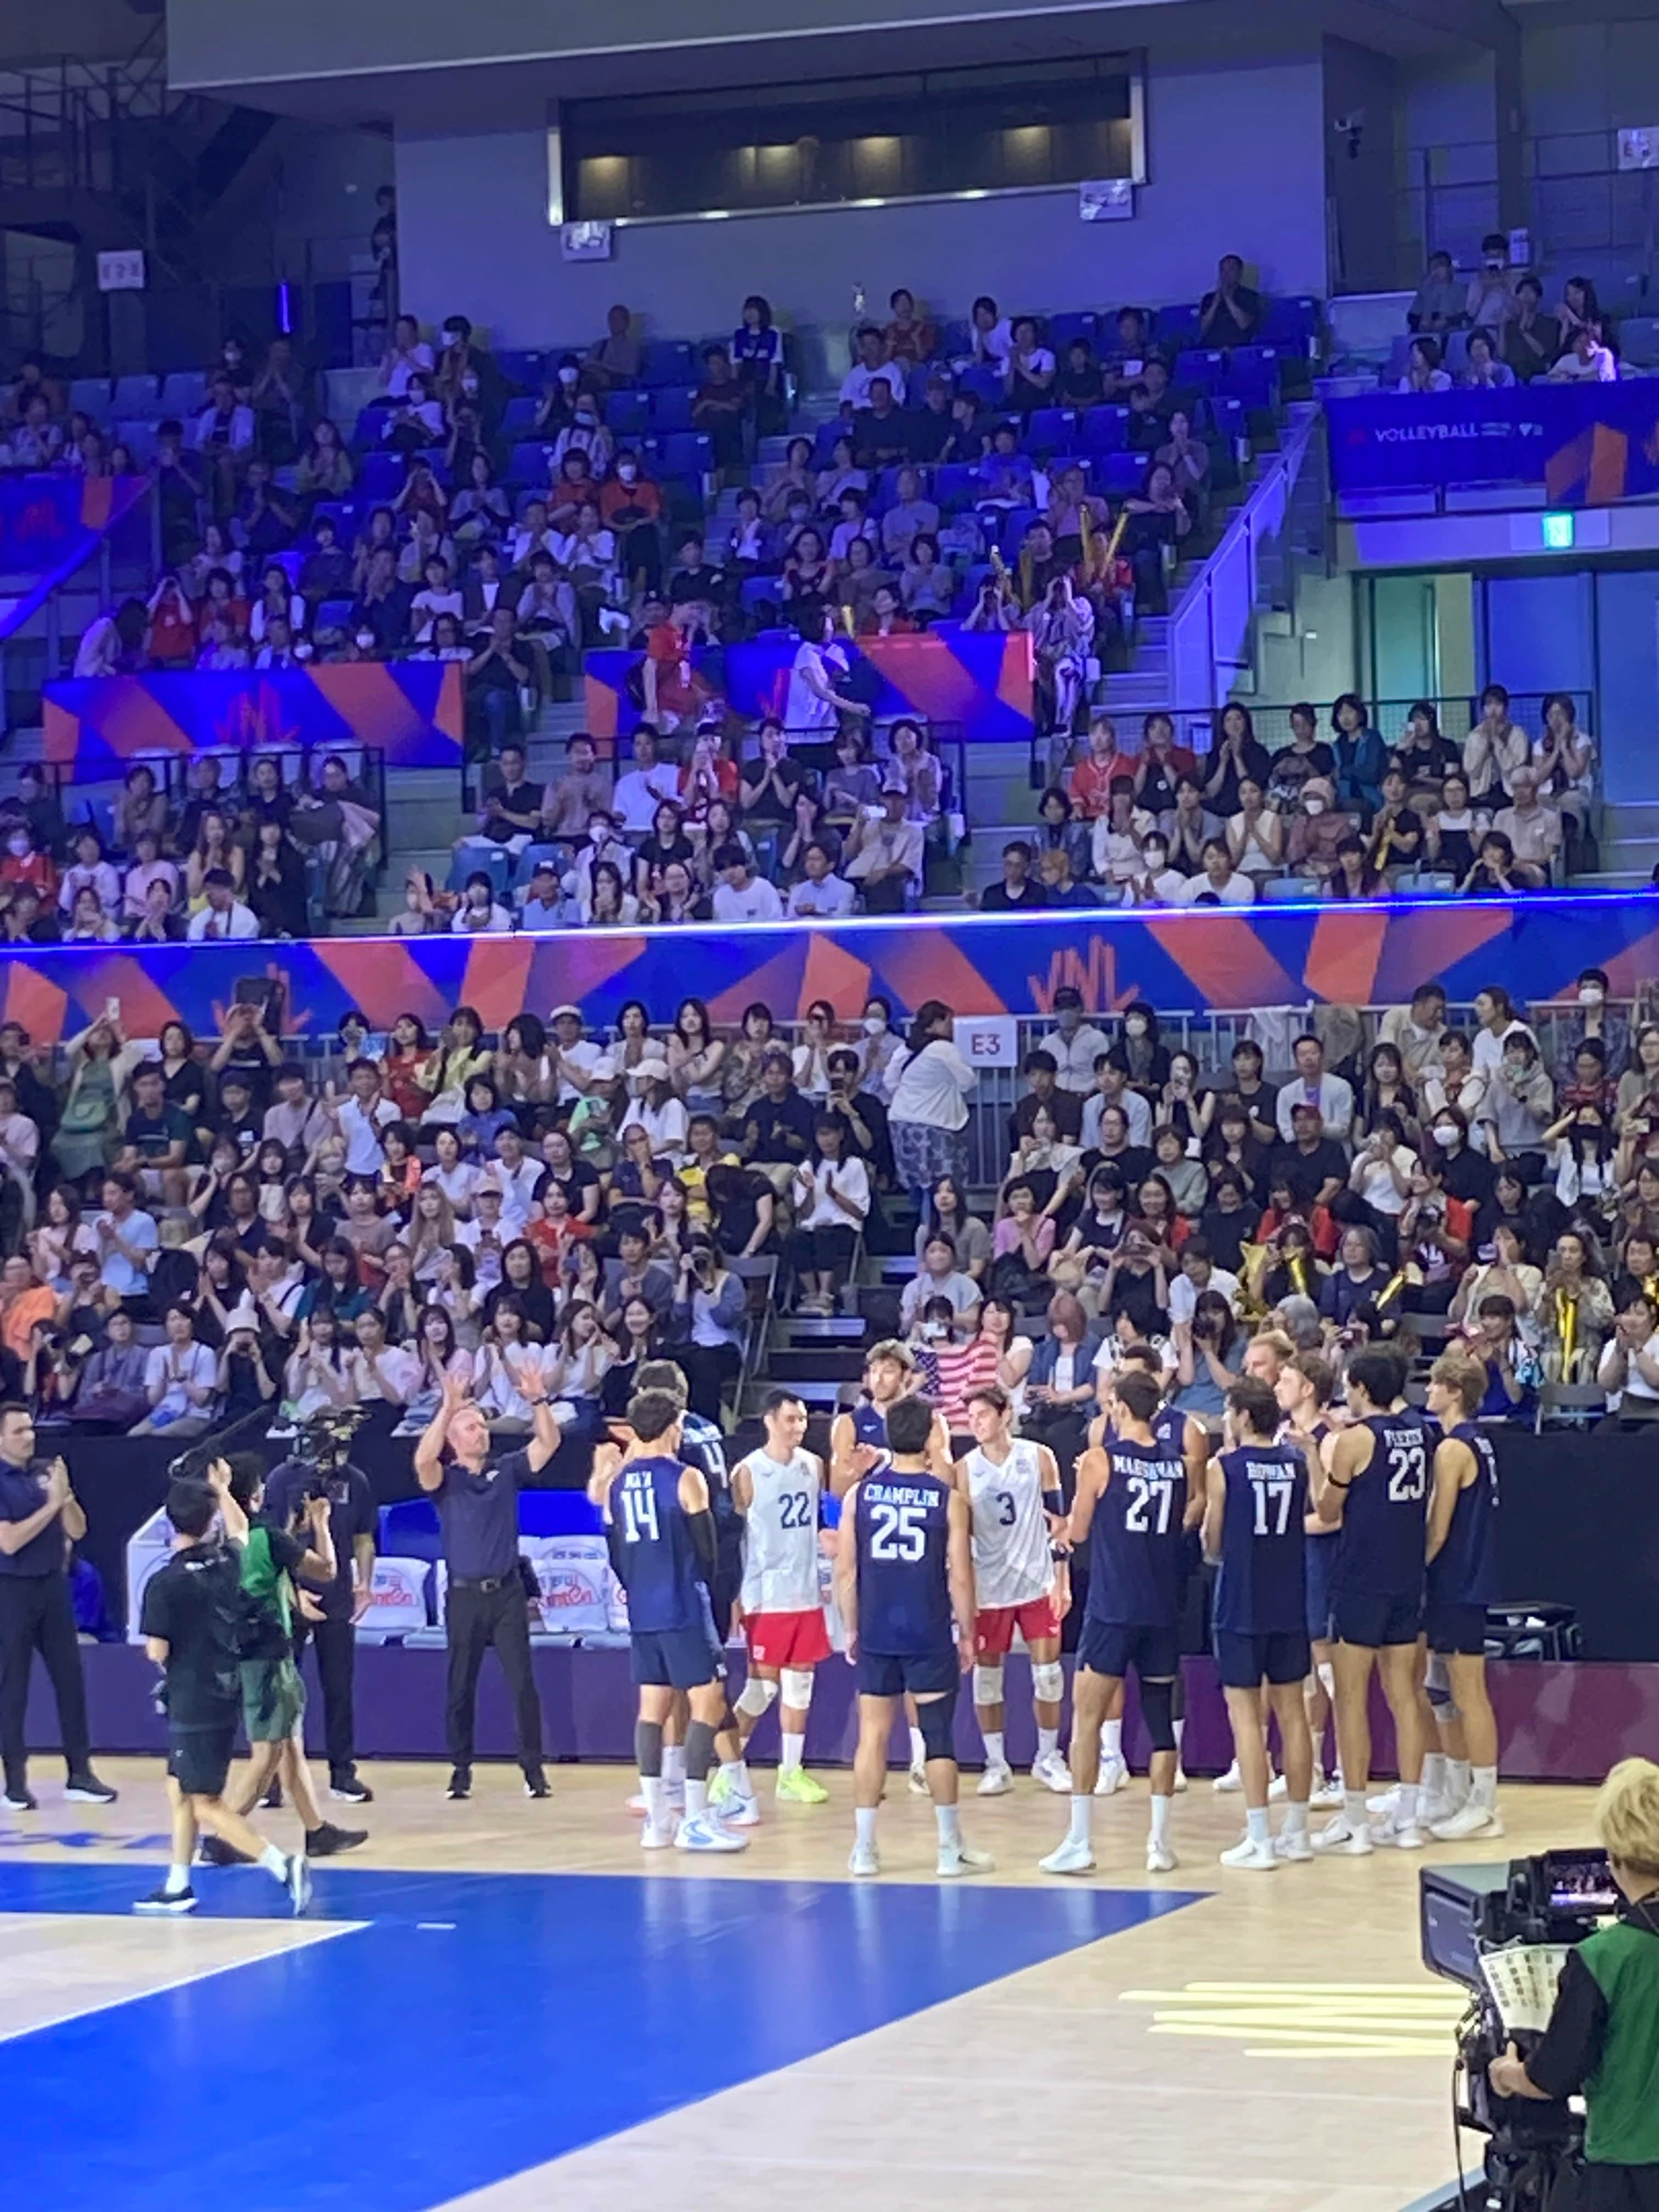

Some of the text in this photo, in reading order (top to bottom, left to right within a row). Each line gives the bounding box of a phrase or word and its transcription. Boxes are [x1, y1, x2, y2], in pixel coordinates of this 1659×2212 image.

[1375, 422, 1480, 442] VOLLEYBALL
[971, 1034, 1001, 1056] E3
[701, 1441, 728, 1488] 4
[1388, 1447, 1426, 1501] 23
[620, 1487, 660, 1543] 14
[778, 1491, 812, 1529] 22
[864, 1483, 940, 1508] CHAMPLIN
[996, 1491, 1017, 1526] 3
[1126, 1477, 1173, 1534] 27
[1252, 1481, 1293, 1535] 17
[870, 1504, 927, 1562] 25
